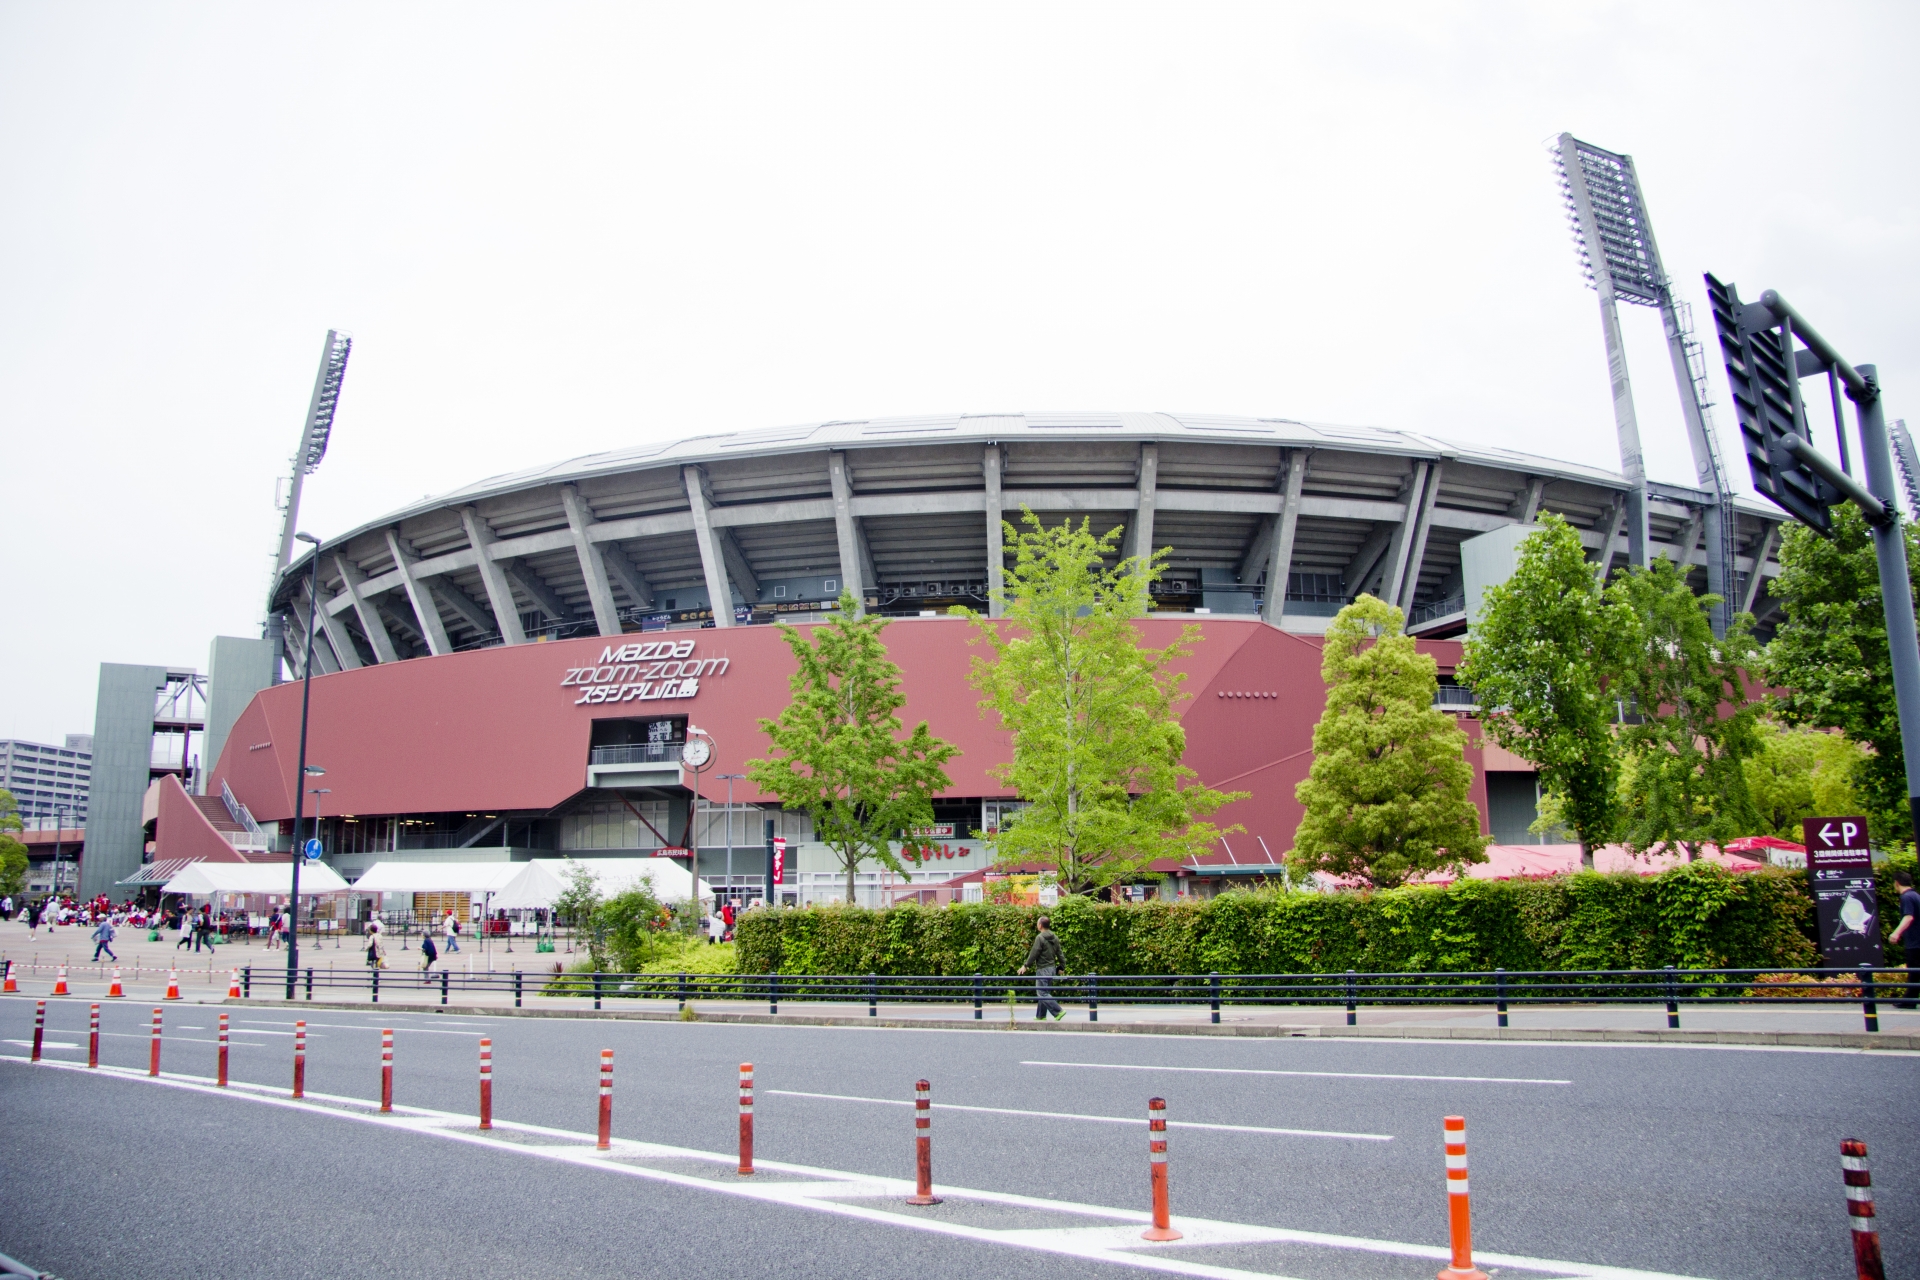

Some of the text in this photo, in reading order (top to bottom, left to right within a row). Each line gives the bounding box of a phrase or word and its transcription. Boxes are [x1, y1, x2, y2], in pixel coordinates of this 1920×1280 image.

[574, 677, 699, 705] スタジアム広島
[1842, 822, 1858, 846] P
